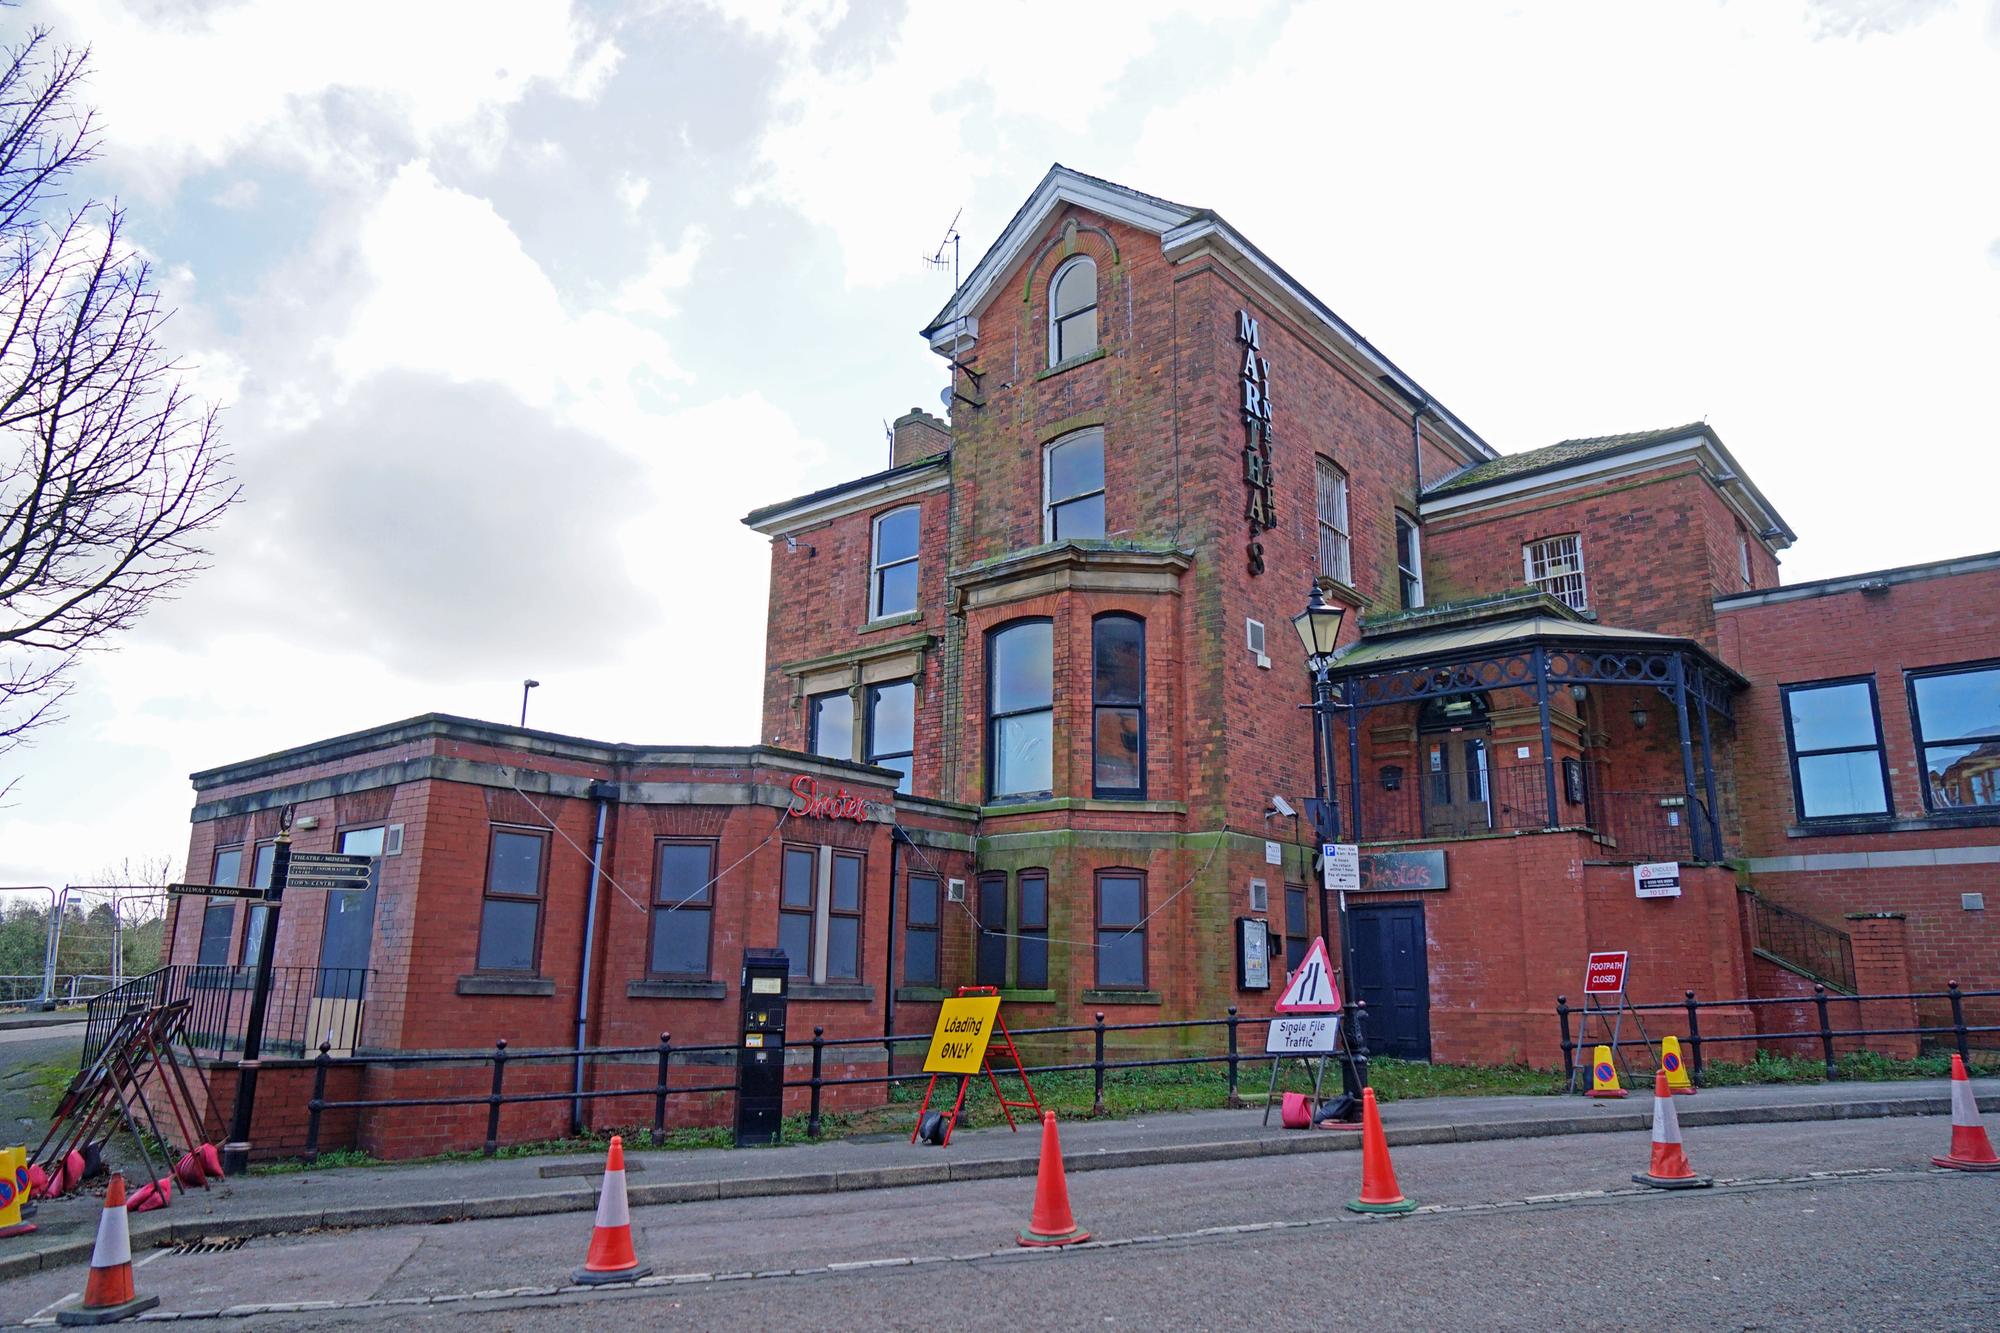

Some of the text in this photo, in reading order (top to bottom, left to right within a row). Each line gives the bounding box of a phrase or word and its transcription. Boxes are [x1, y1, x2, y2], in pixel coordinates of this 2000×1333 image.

[1257, 357, 1277, 529] VINEYARD
[1327, 847, 1334, 855] P
[1590, 962, 1622, 971] FOOTPATH
[1592, 975, 1616, 983] CLOSED
[944, 1016, 984, 1036] Loading
[1280, 1021, 1326, 1034] Single File
[1285, 1037, 1313, 1047] Traffic
[941, 1042, 972, 1059] ONLY
